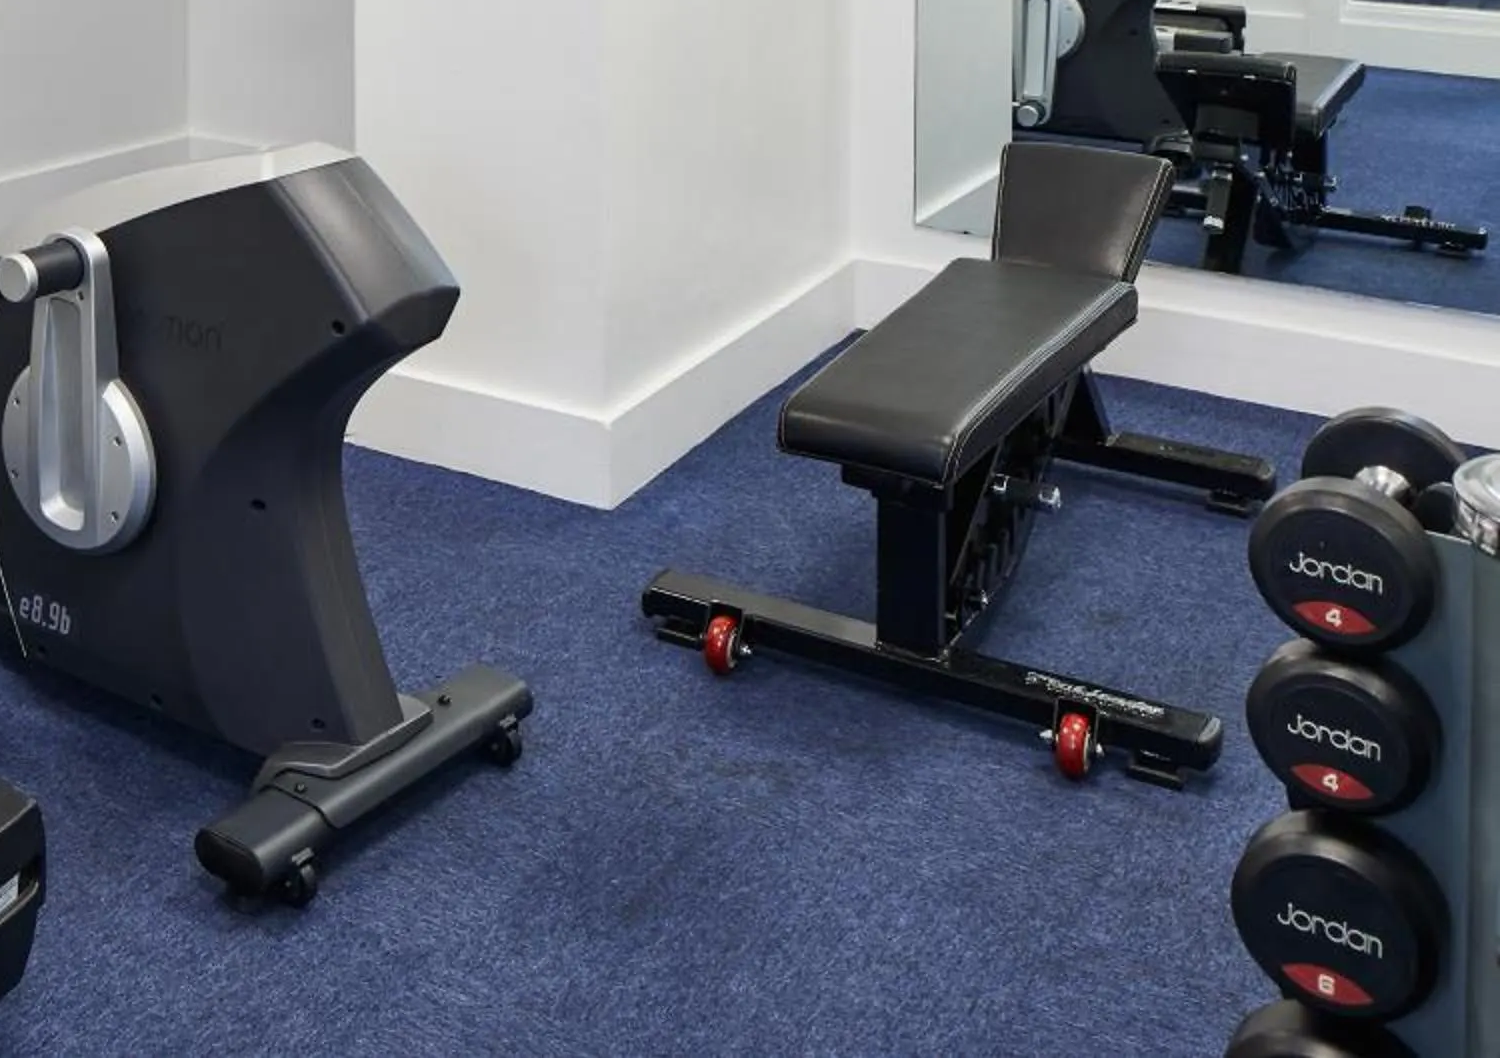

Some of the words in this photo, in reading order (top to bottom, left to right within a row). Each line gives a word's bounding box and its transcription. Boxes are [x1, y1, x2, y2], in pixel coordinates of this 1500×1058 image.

[1289, 551, 1383, 595] Jordan
[19, 594, 71, 635] e8.9b
[1325, 608, 1342, 628] 4
[1287, 714, 1381, 762] Jordan
[1323, 773, 1339, 792] 4
[1277, 902, 1383, 959] Jordan
